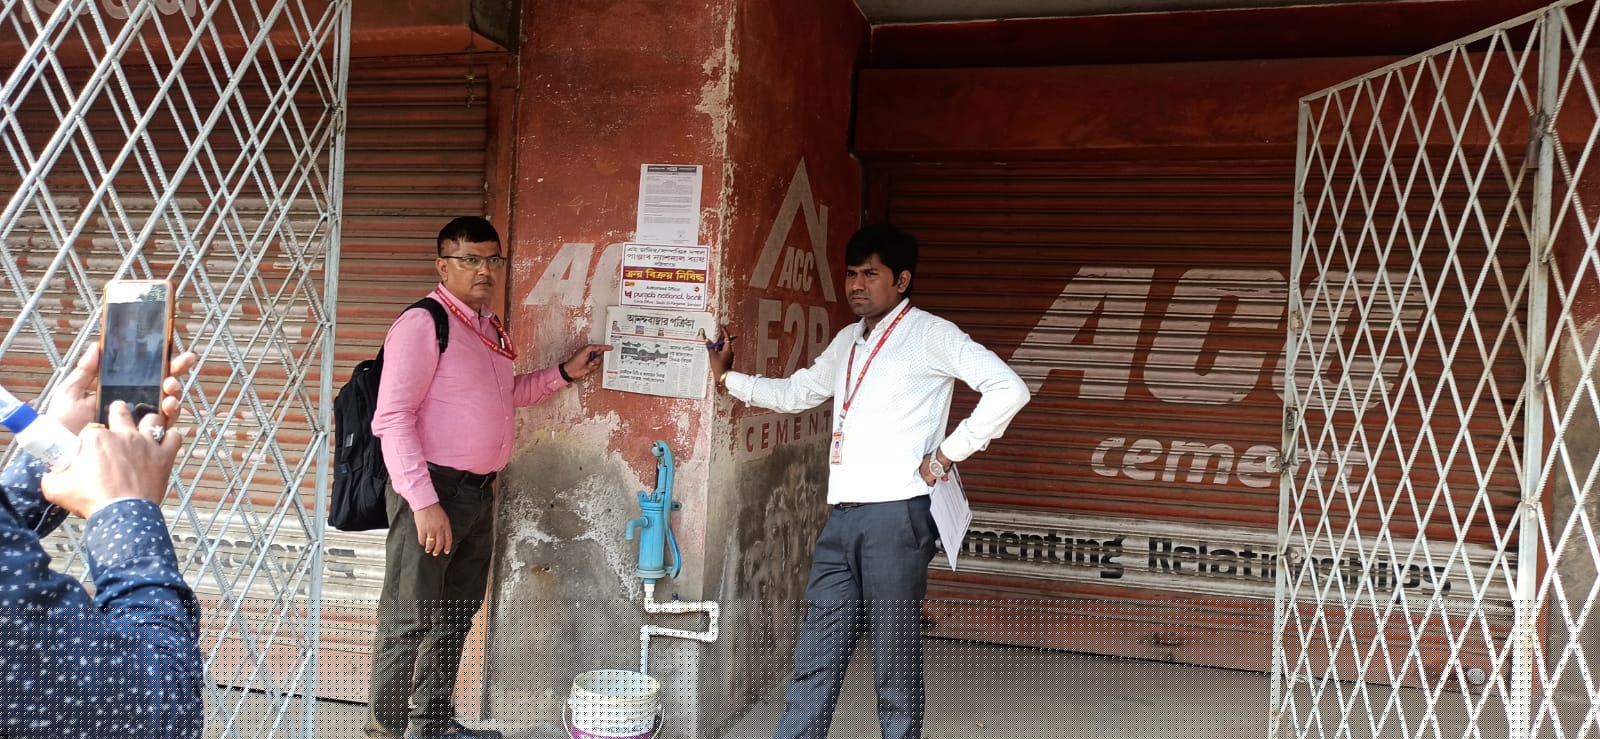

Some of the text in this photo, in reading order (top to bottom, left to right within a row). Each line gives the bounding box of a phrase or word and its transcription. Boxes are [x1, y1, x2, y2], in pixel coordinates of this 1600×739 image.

[777, 246, 815, 292] ACC
[657, 292, 684, 300] national
[686, 293, 703, 301] bank
[1007, 266, 1425, 410] ACC
[745, 410, 832, 453] CEMENT
[938, 528, 1126, 579] menting
